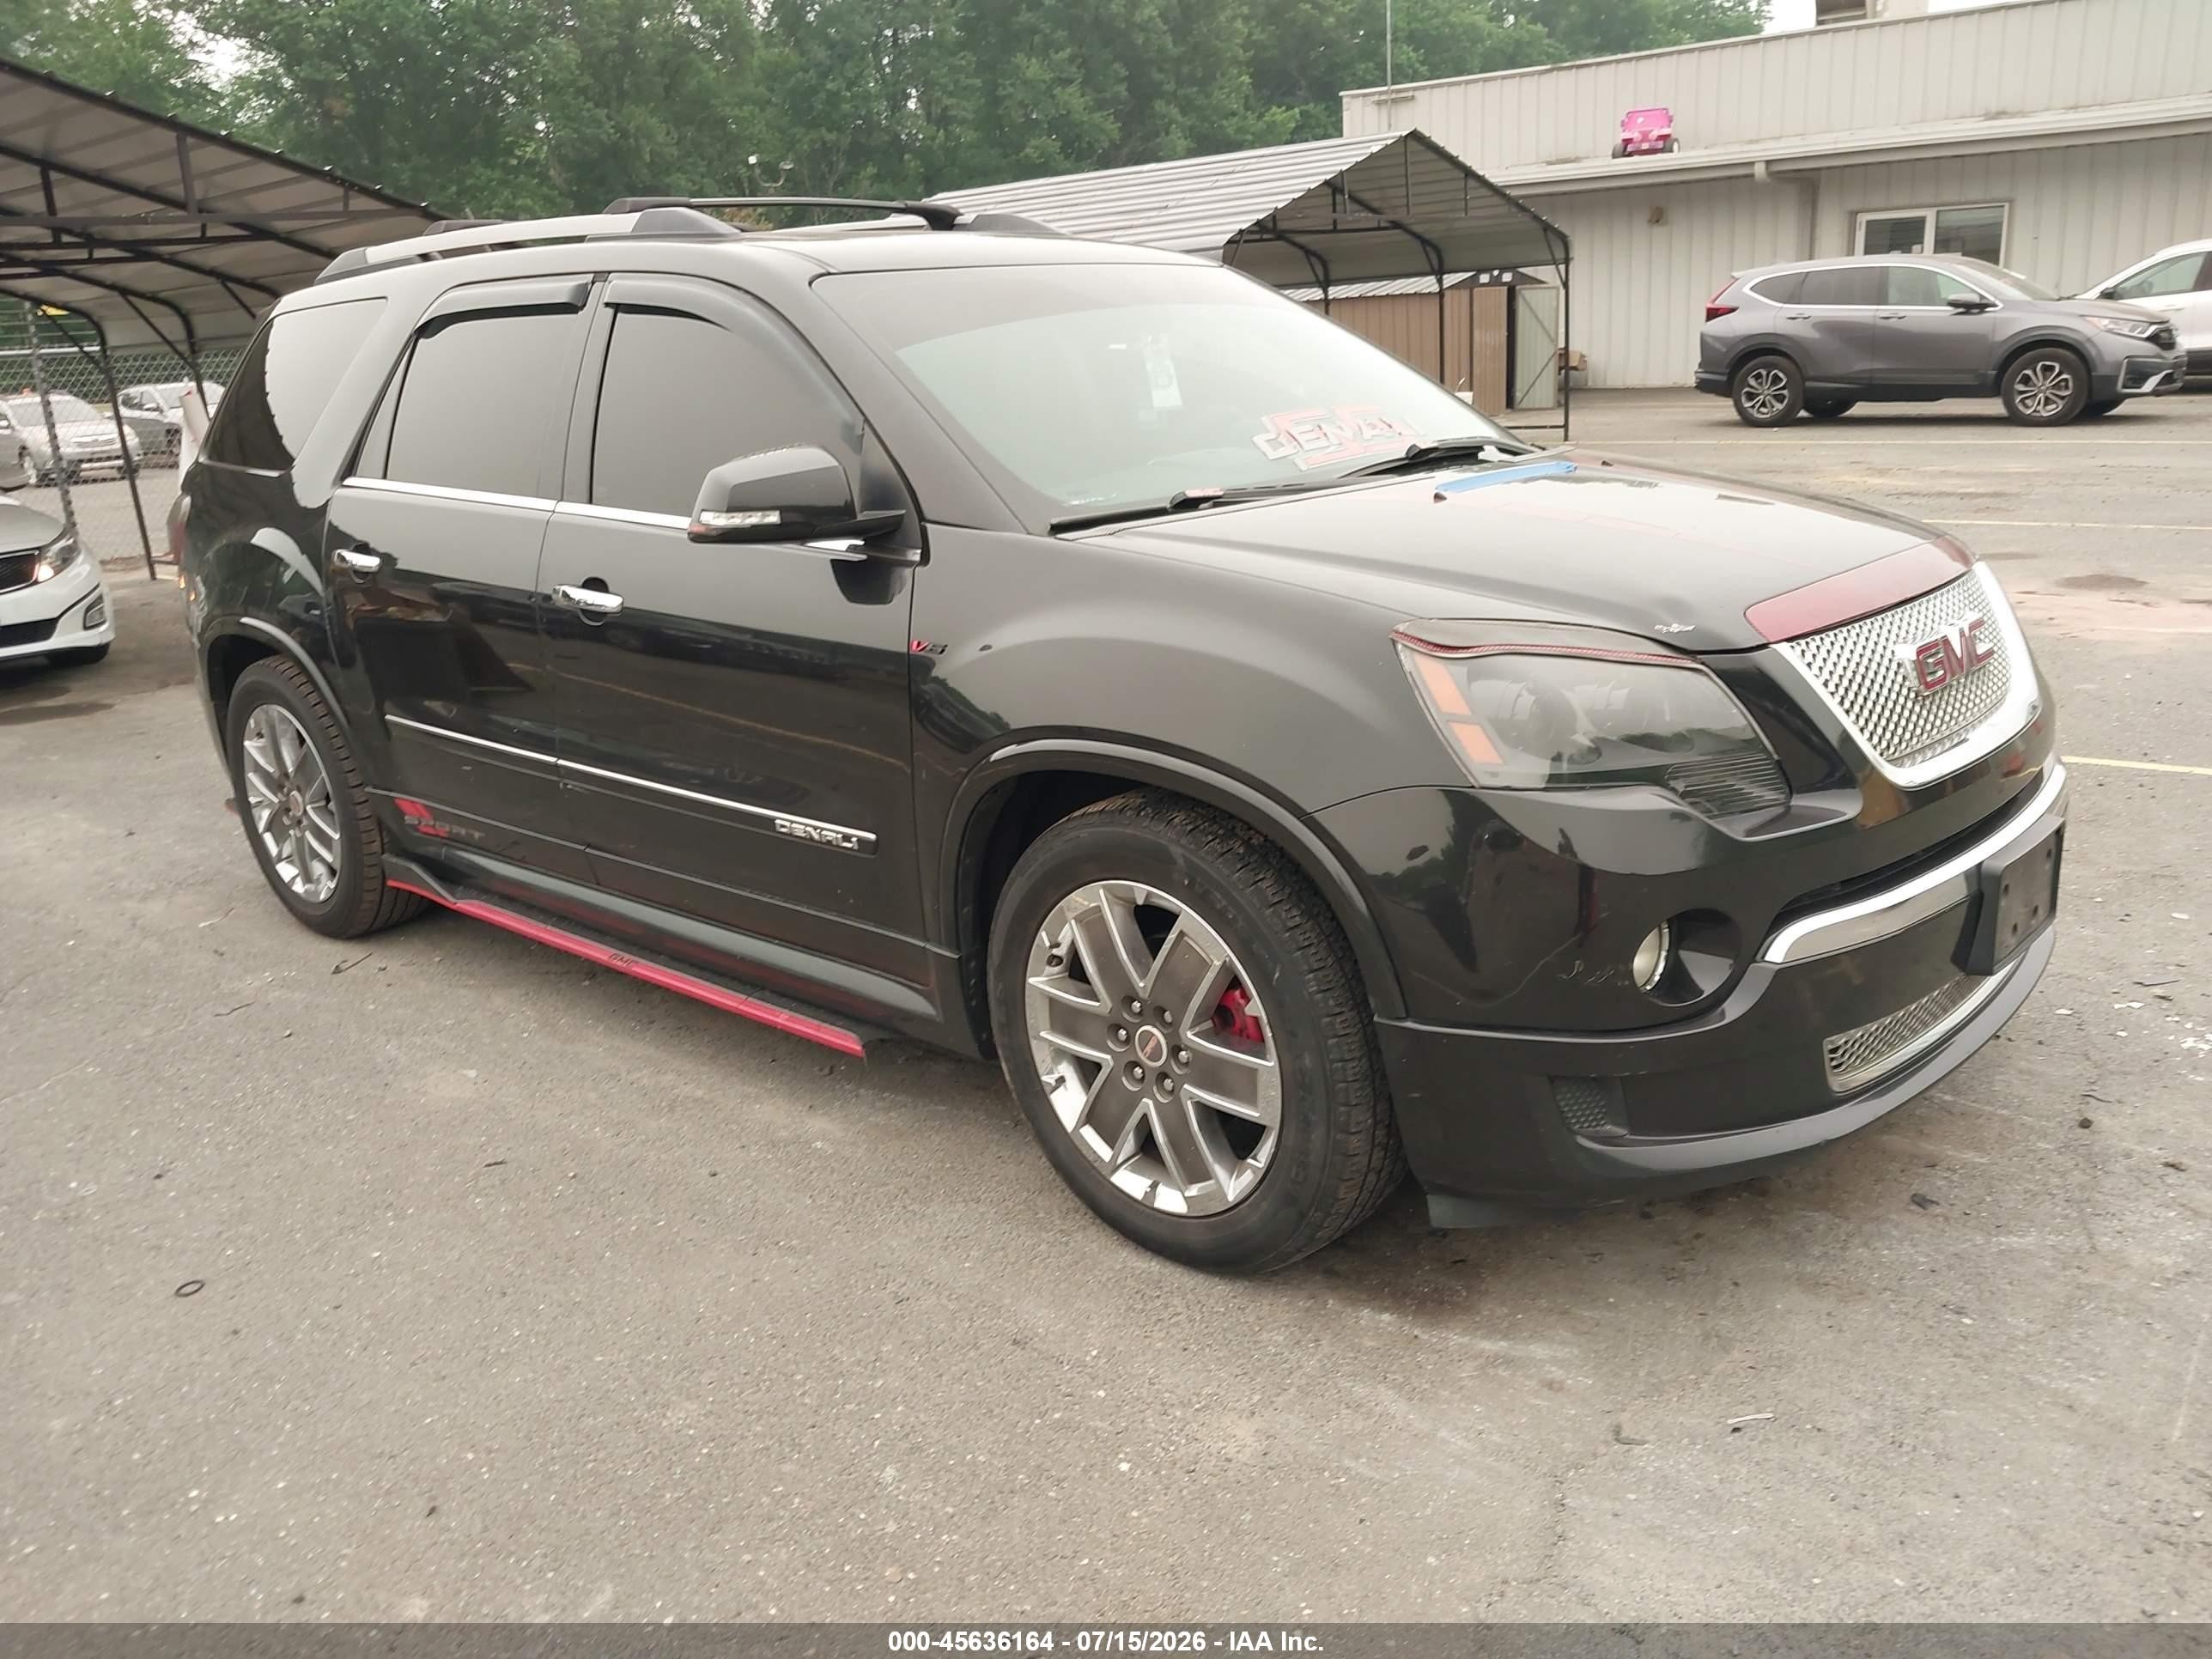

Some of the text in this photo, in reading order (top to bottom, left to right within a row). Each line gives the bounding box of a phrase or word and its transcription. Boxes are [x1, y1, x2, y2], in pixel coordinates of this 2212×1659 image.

[1915, 617, 1995, 692] GMC
[404, 815, 486, 840] SPORT
[775, 818, 860, 850] DENALI
